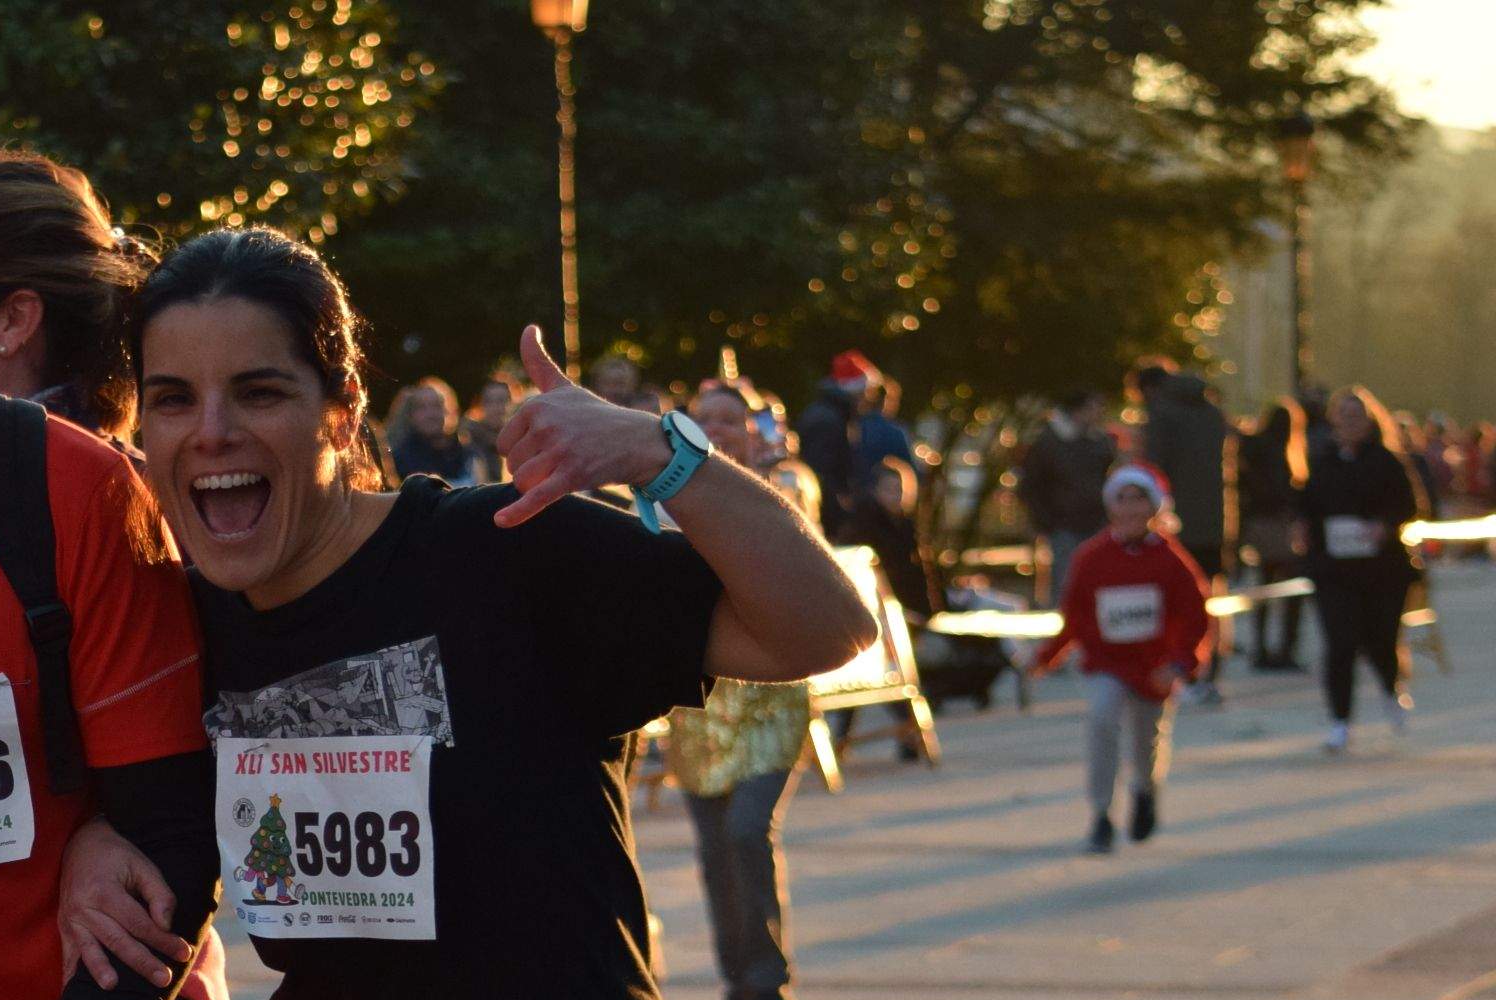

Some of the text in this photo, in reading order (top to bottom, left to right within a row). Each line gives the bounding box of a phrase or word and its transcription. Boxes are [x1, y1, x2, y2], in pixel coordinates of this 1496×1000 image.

[234, 750, 412, 775] XLI SAN SILVESTRE
[293, 810, 421, 878] 5983
[301, 891, 415, 907] PONTEVEDRA 2024
